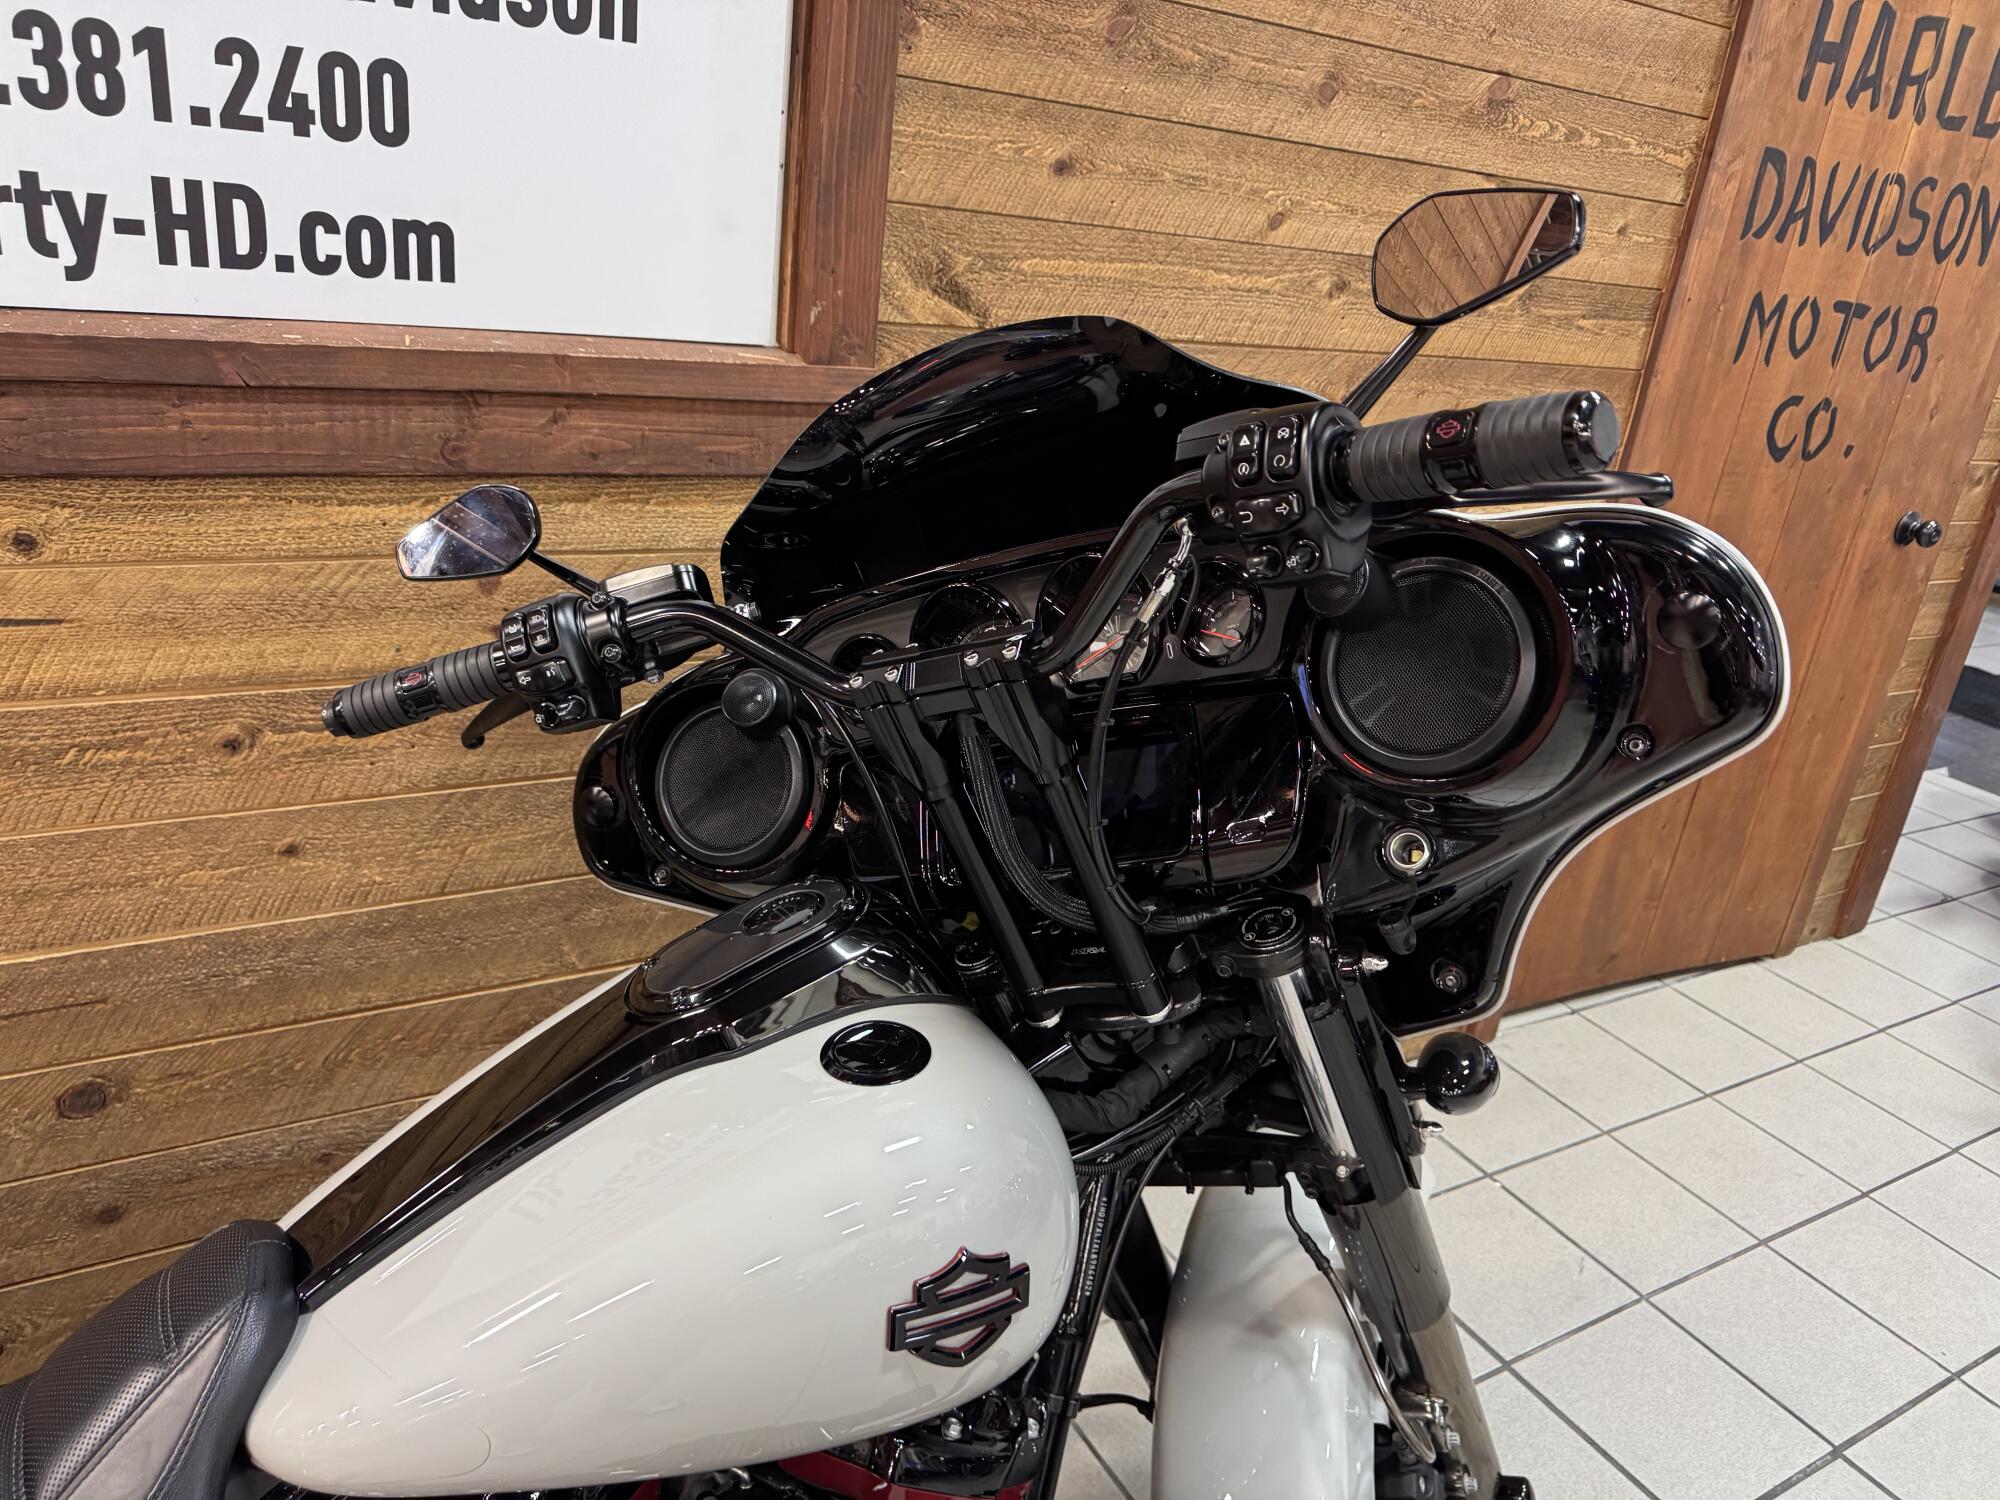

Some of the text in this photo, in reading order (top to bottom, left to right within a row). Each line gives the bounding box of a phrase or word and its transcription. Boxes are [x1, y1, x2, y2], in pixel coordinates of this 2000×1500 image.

[1740, 146, 2000, 268] DAVIDSON
[1733, 290, 1938, 382] MOTOR
[1767, 395, 1854, 463] CO.
